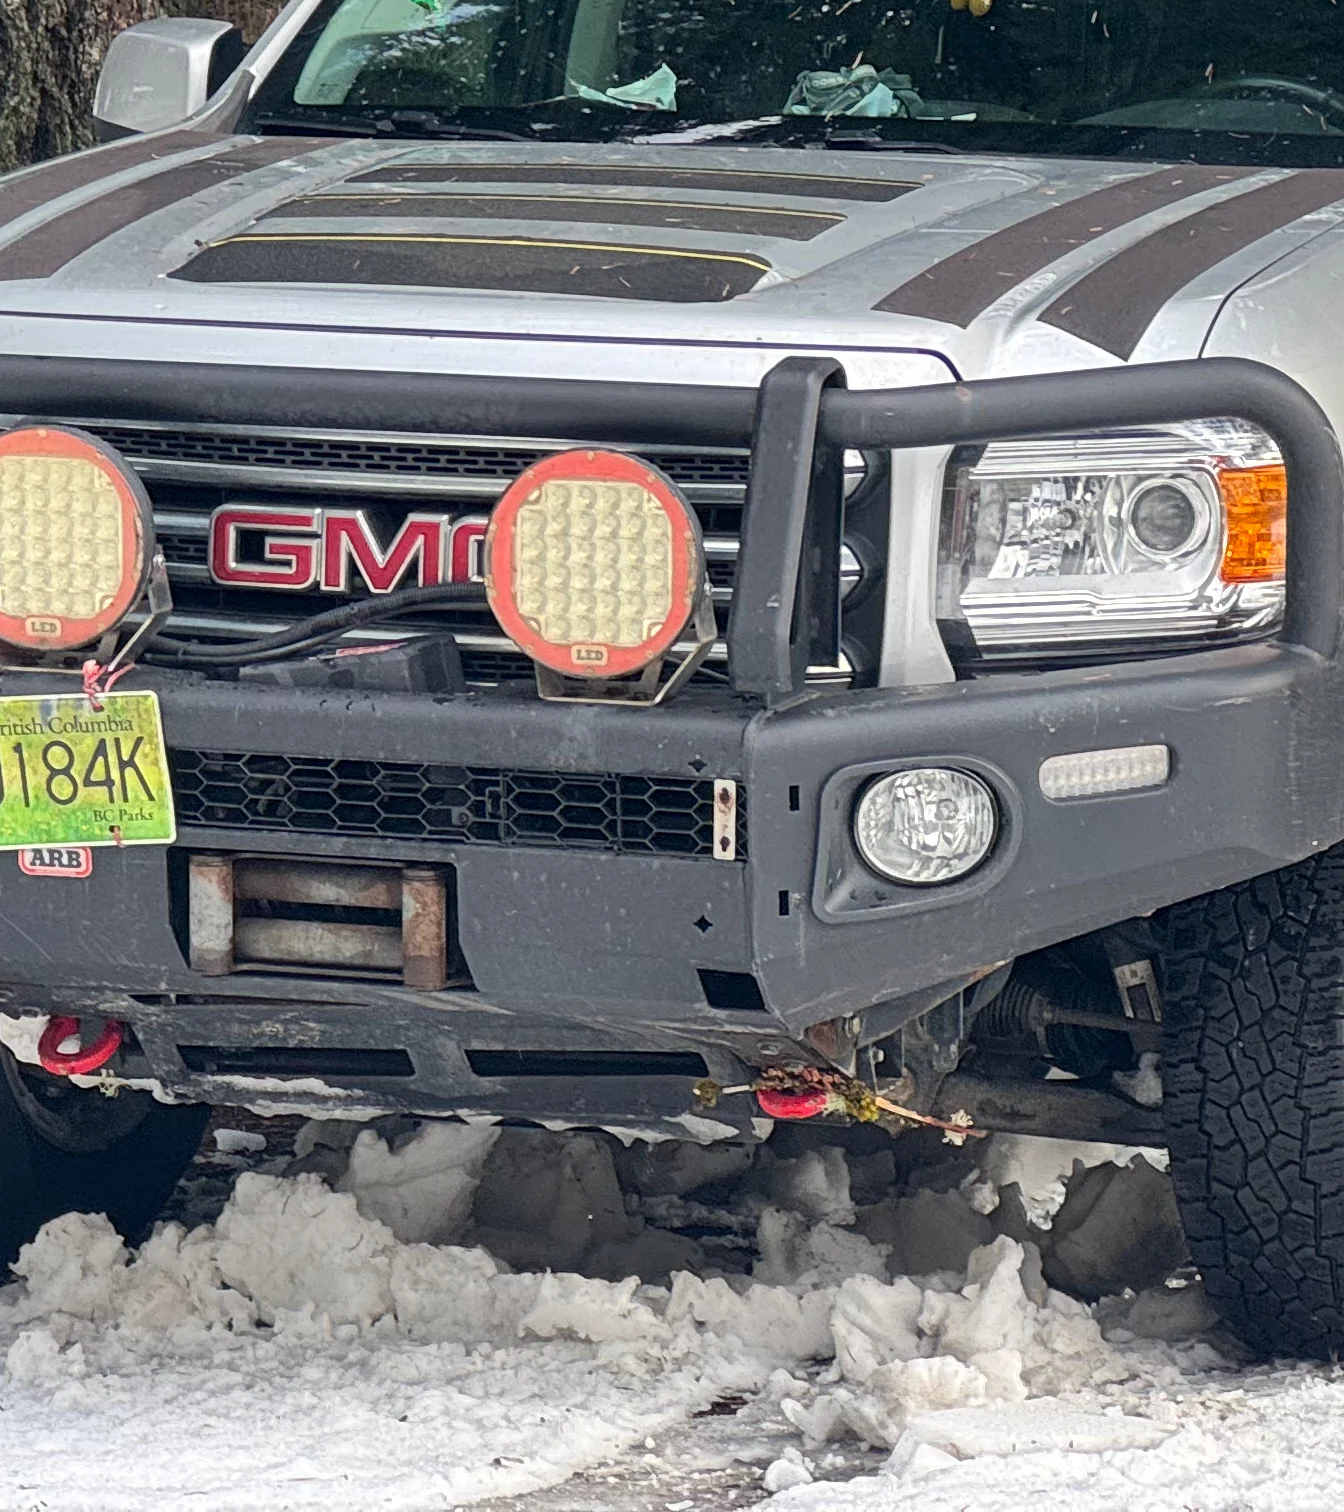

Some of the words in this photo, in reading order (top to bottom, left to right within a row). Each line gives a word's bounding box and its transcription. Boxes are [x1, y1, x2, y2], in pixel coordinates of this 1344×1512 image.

[30, 621, 58, 633] LED
[576, 648, 604, 661] LED
[48, 712, 134, 734] Columbia
[93, 810, 115, 823] BC
[118, 808, 154, 821] Parks
[29, 848, 82, 869] ARB
